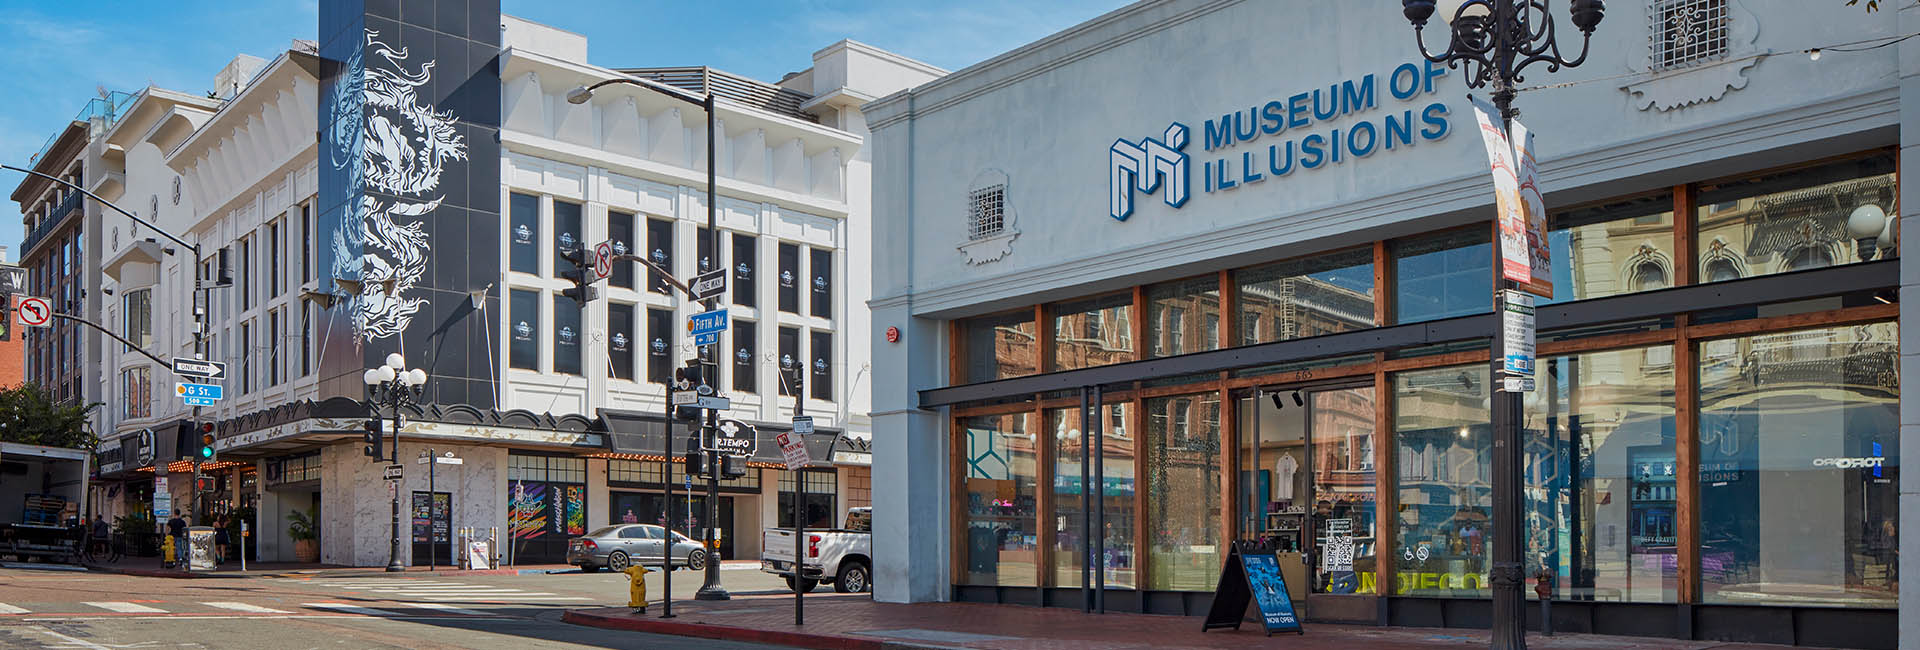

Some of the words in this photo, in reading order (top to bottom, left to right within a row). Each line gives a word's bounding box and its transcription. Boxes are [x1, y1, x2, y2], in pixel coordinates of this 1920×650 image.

[1204, 73, 1377, 152] MUSEUM
[1390, 58, 1448, 100] OF
[1204, 103, 1450, 193] ILLUSIONS
[700, 281, 710, 292] ONE
[711, 278, 721, 289] WAY
[695, 318, 713, 331] FIFTH
[188, 386, 195, 395] G
[717, 438, 750, 448] R.TEMPO
[778, 434, 788, 446] NO
